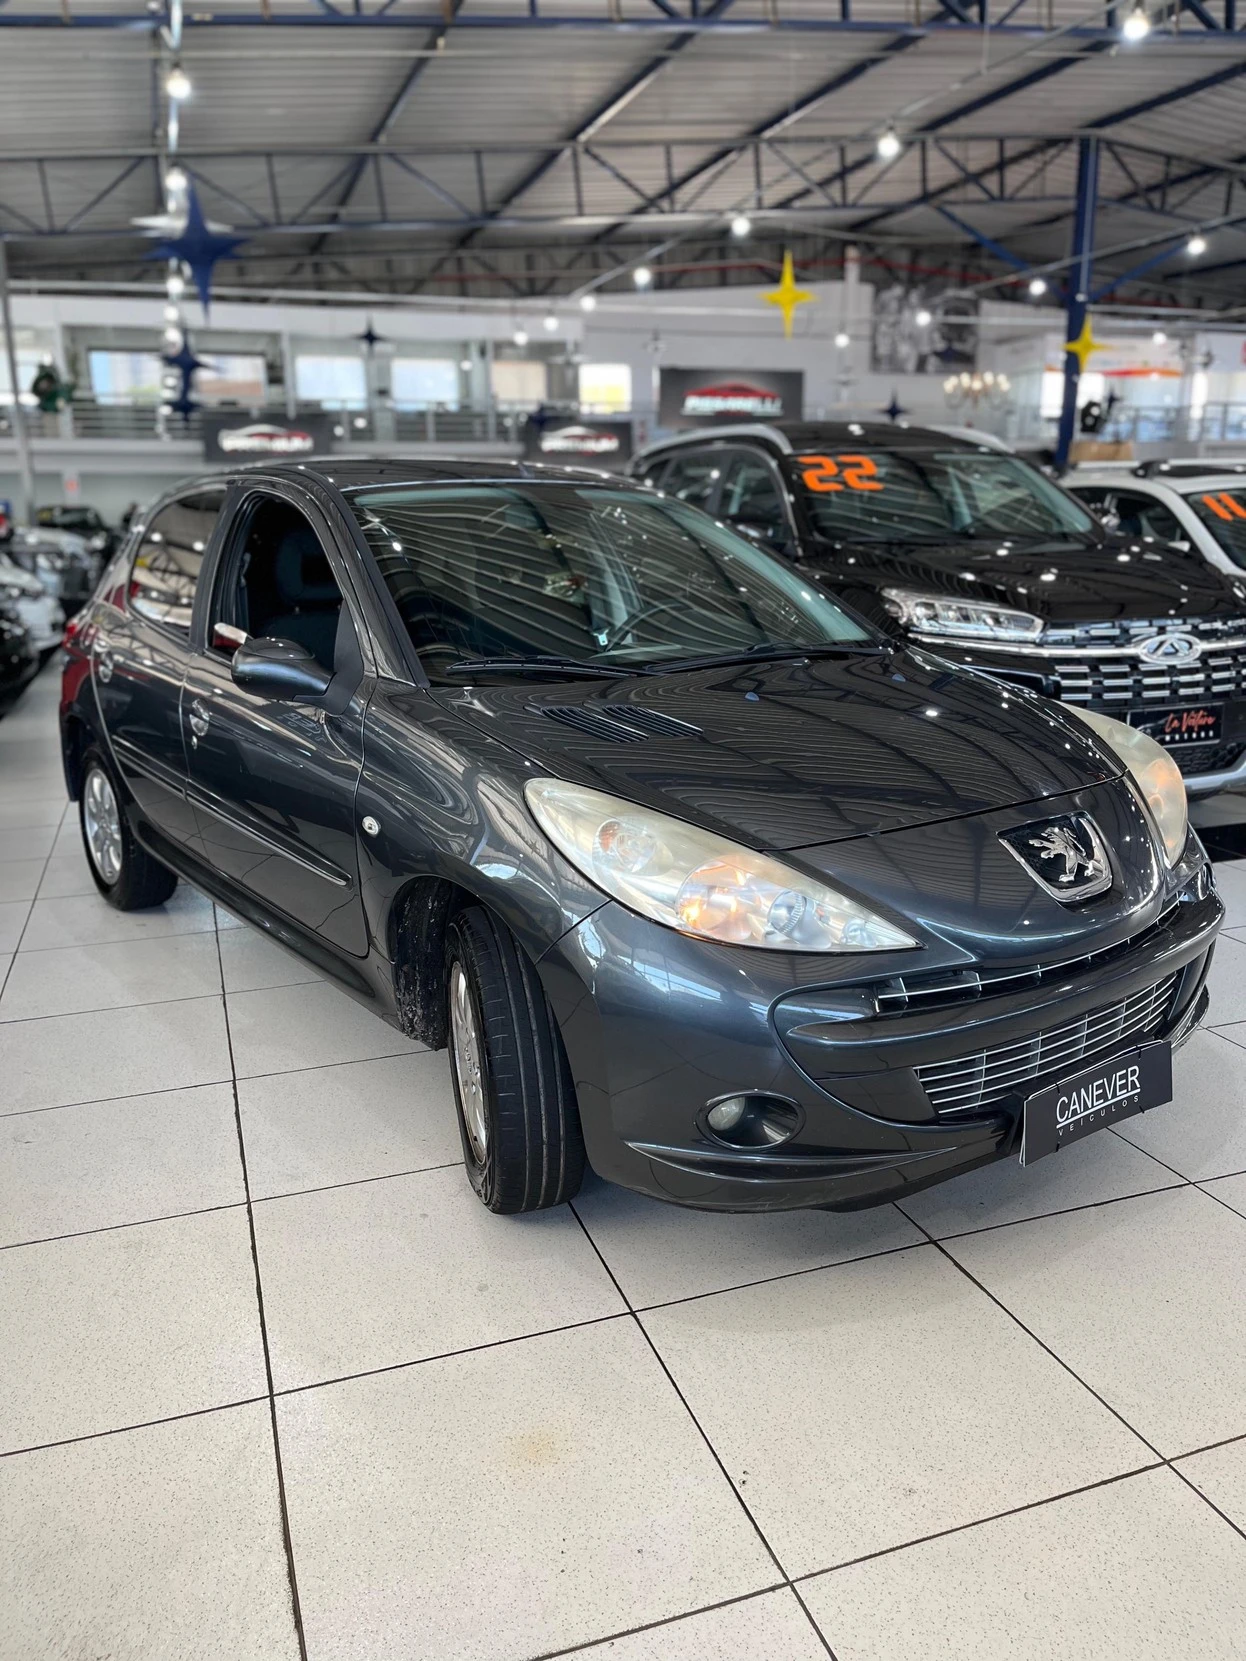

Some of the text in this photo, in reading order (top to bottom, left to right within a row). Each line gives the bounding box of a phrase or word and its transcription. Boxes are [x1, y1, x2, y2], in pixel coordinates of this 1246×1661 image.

[797, 454, 885, 492] 22
[1056, 1064, 1141, 1123] CANEVER
[1058, 1095, 1139, 1136] VEICULOS
